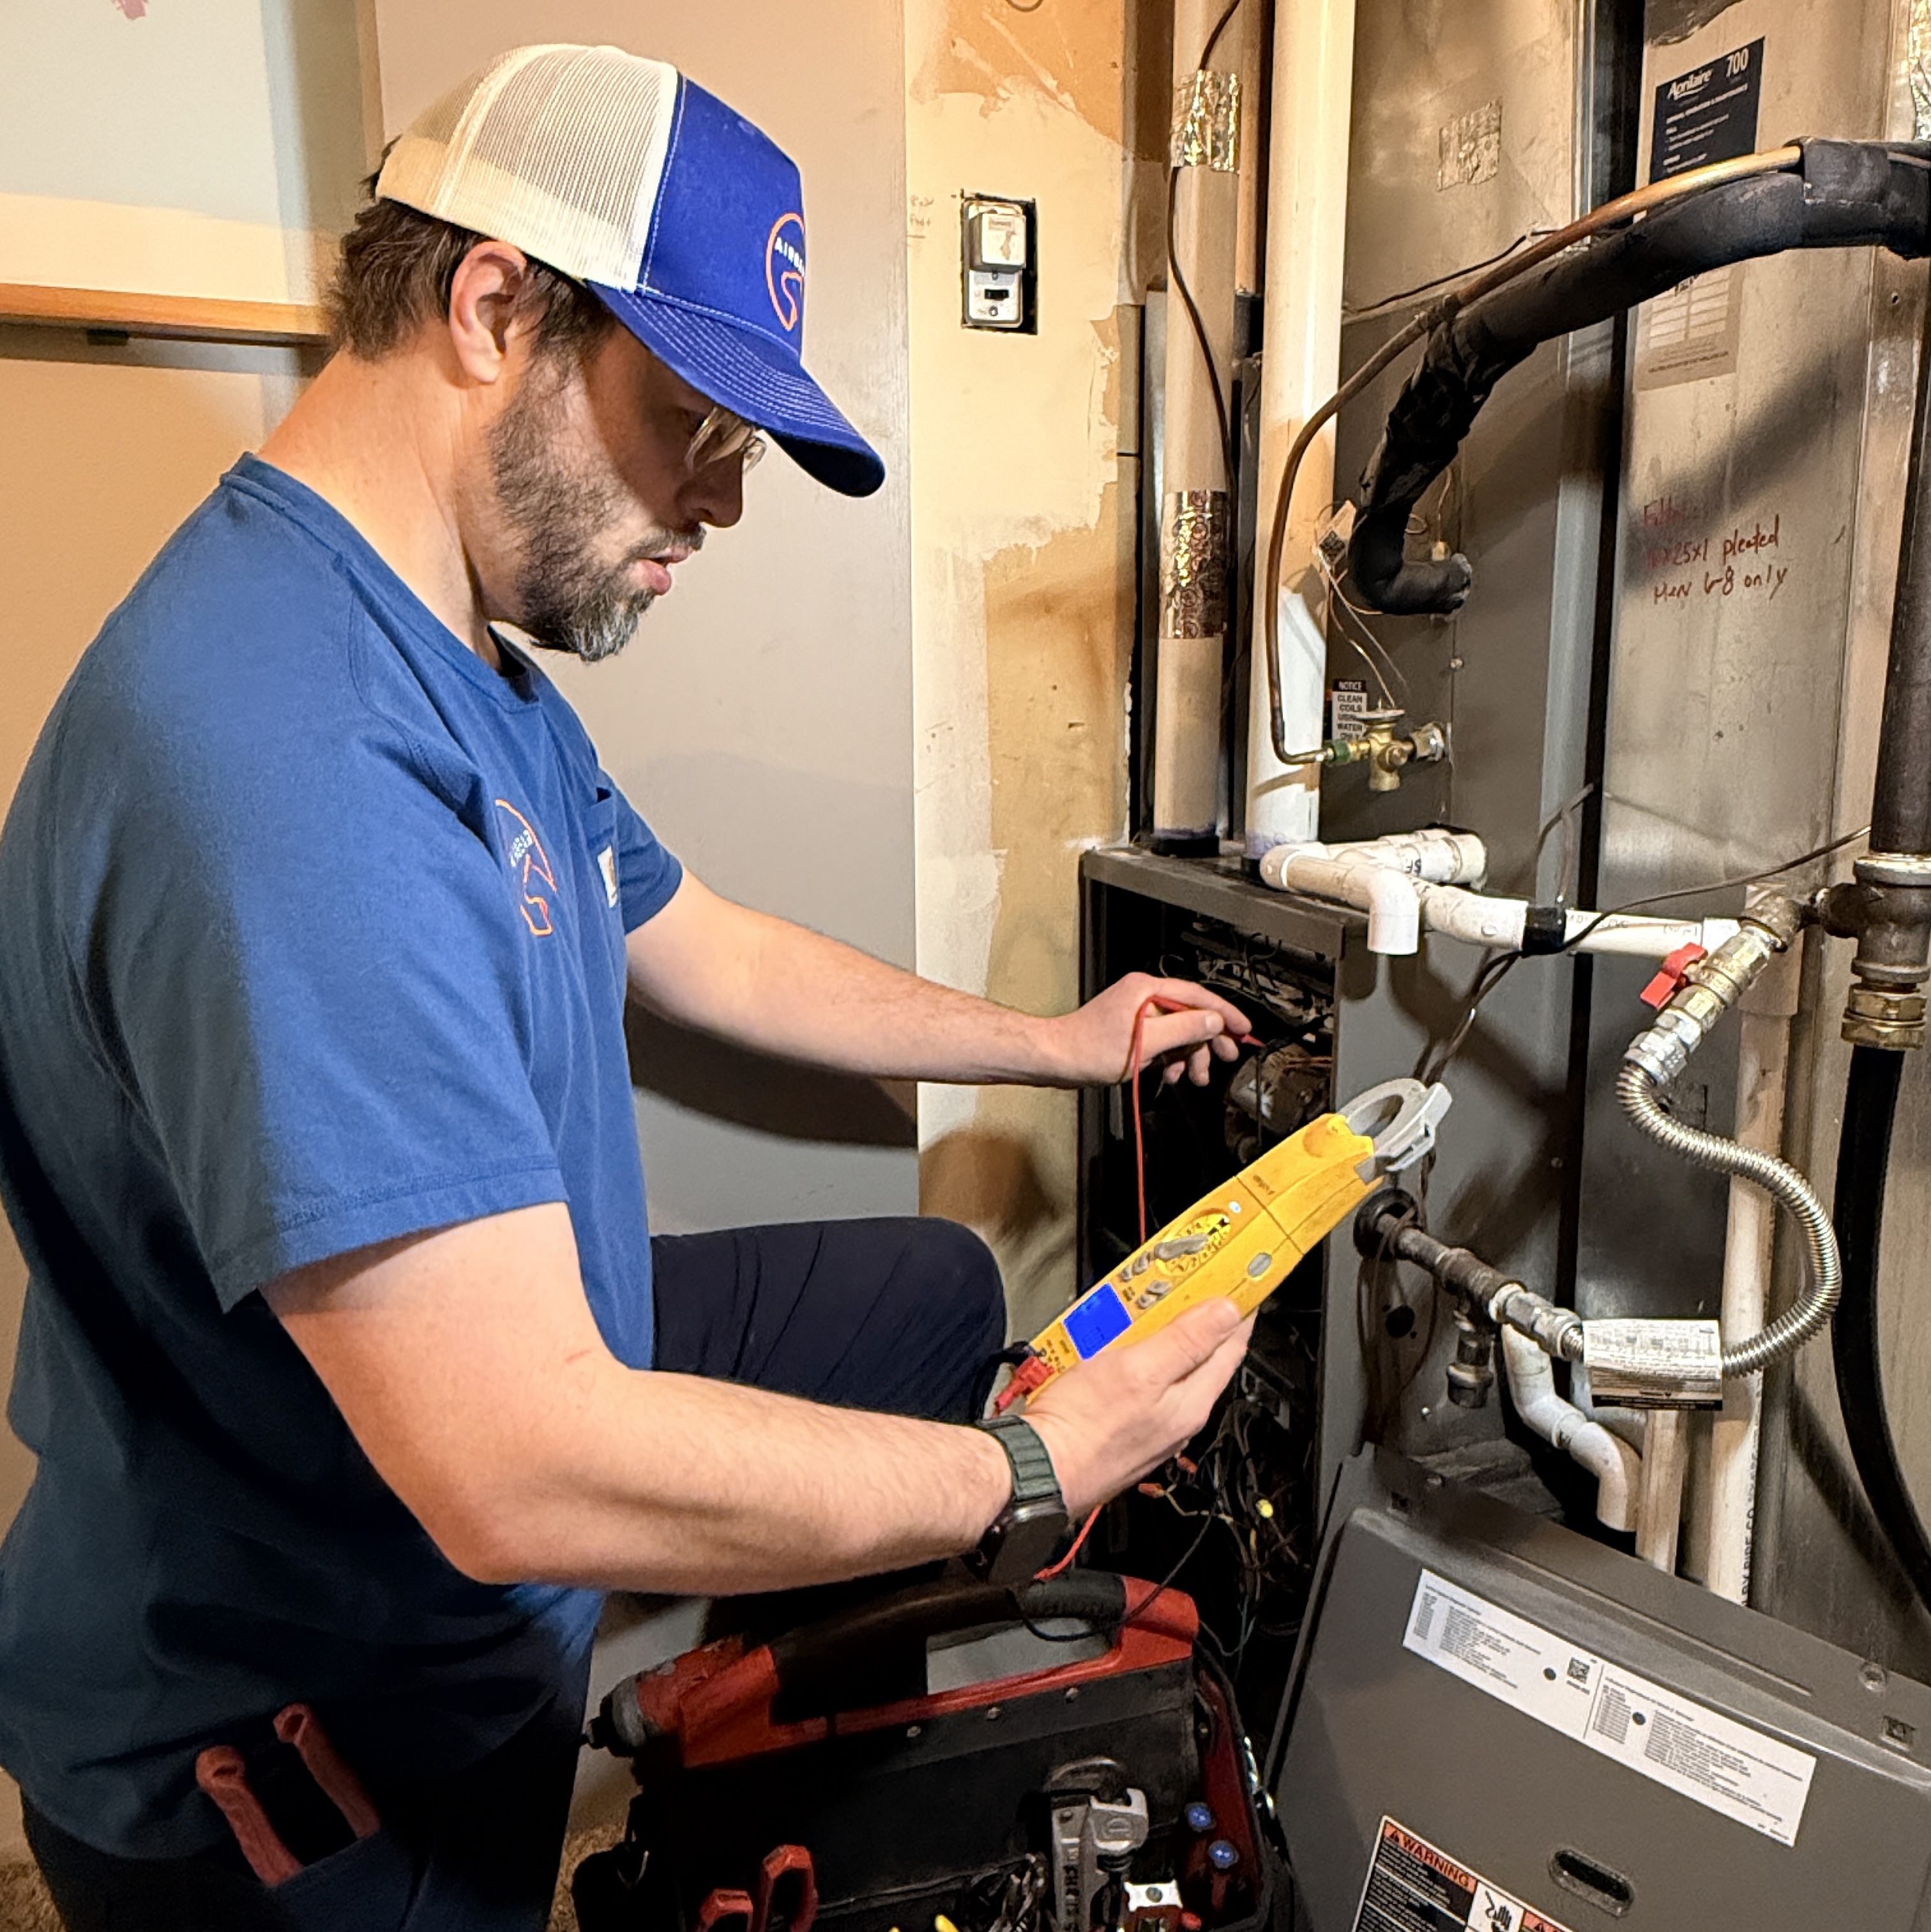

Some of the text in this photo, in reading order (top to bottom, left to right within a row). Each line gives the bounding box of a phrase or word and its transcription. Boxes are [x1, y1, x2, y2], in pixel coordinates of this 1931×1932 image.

[1726, 47, 1748, 78] 700
[1723, 513, 1780, 566] pleated
[1744, 564, 1788, 600] only
[1338, 681, 1361, 690] NOTICE
[1337, 694, 1363, 703] CLEAN
[1339, 704, 1362, 713] COILS
[1337, 723, 1363, 732] WATER
[1403, 1835, 1469, 1887] WARNING
